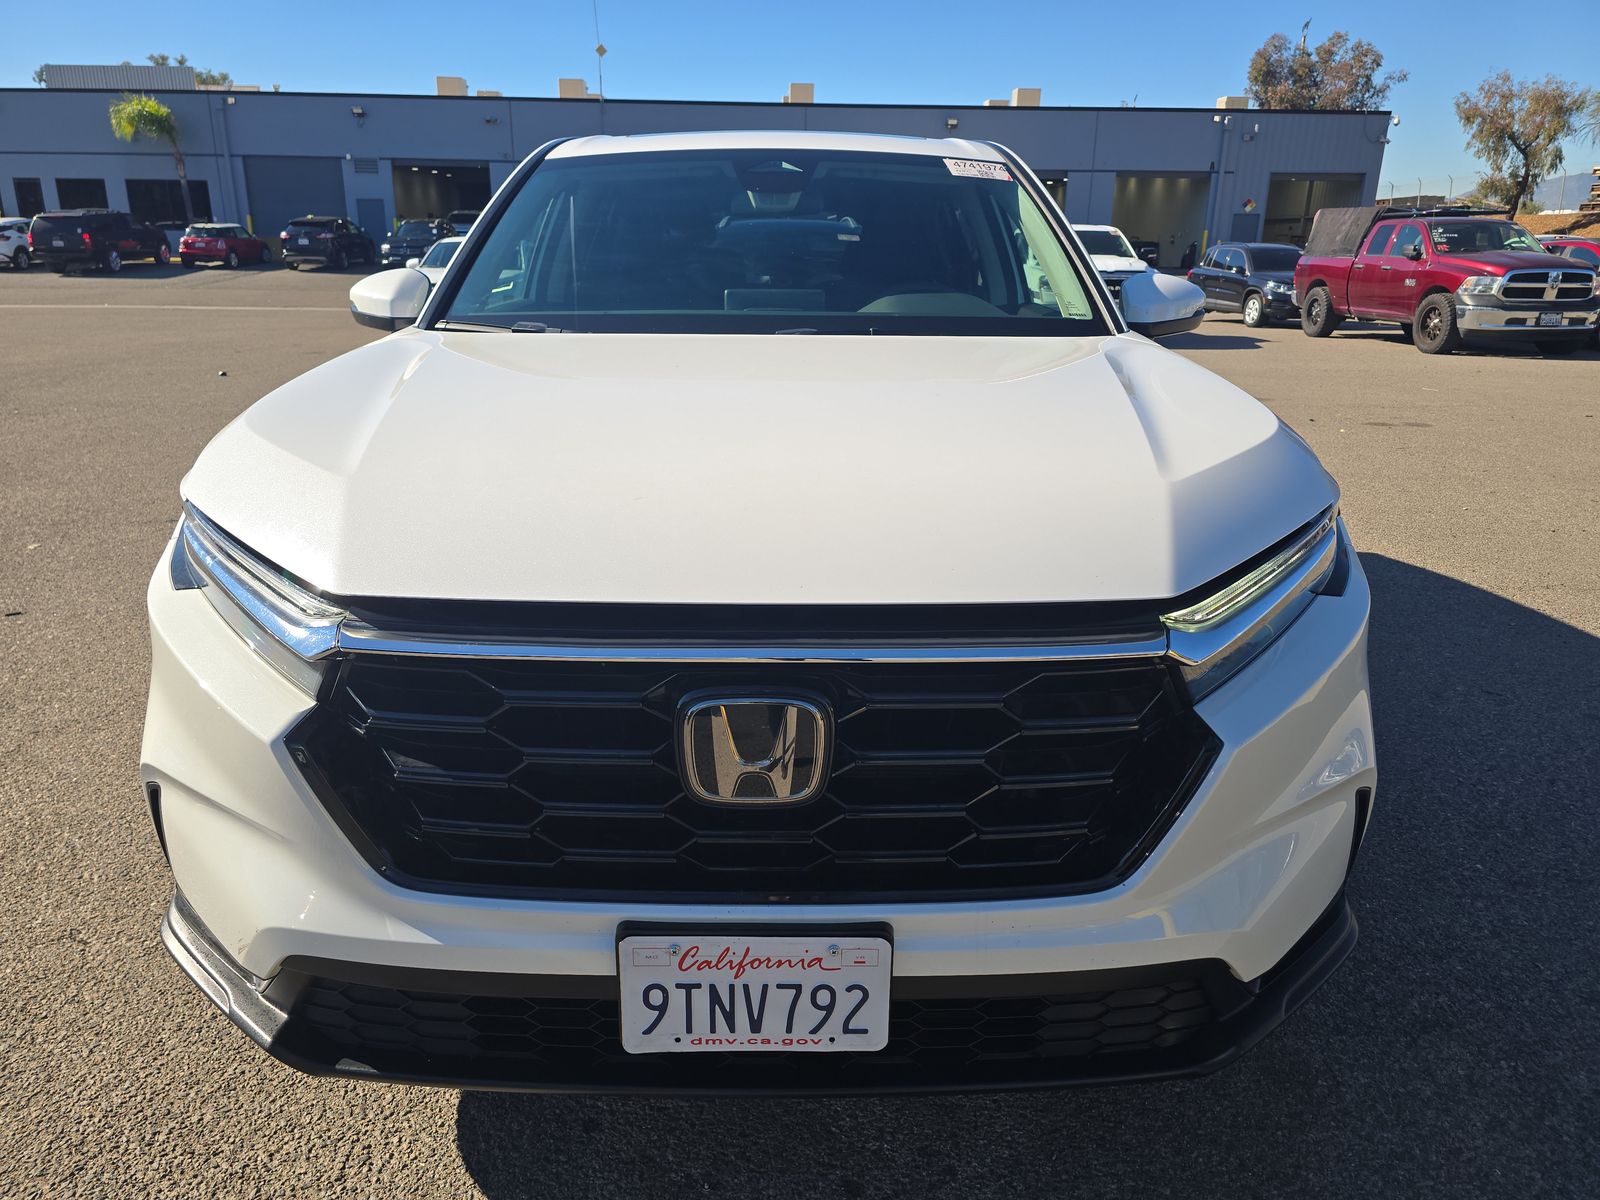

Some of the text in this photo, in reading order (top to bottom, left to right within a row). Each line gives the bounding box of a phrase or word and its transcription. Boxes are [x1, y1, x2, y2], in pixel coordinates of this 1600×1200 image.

[953, 161, 1006, 172] 4741974
[677, 945, 842, 980] California
[641, 983, 870, 1036] 9TNV792
[690, 1036, 823, 1047] dmv.ca.gov
